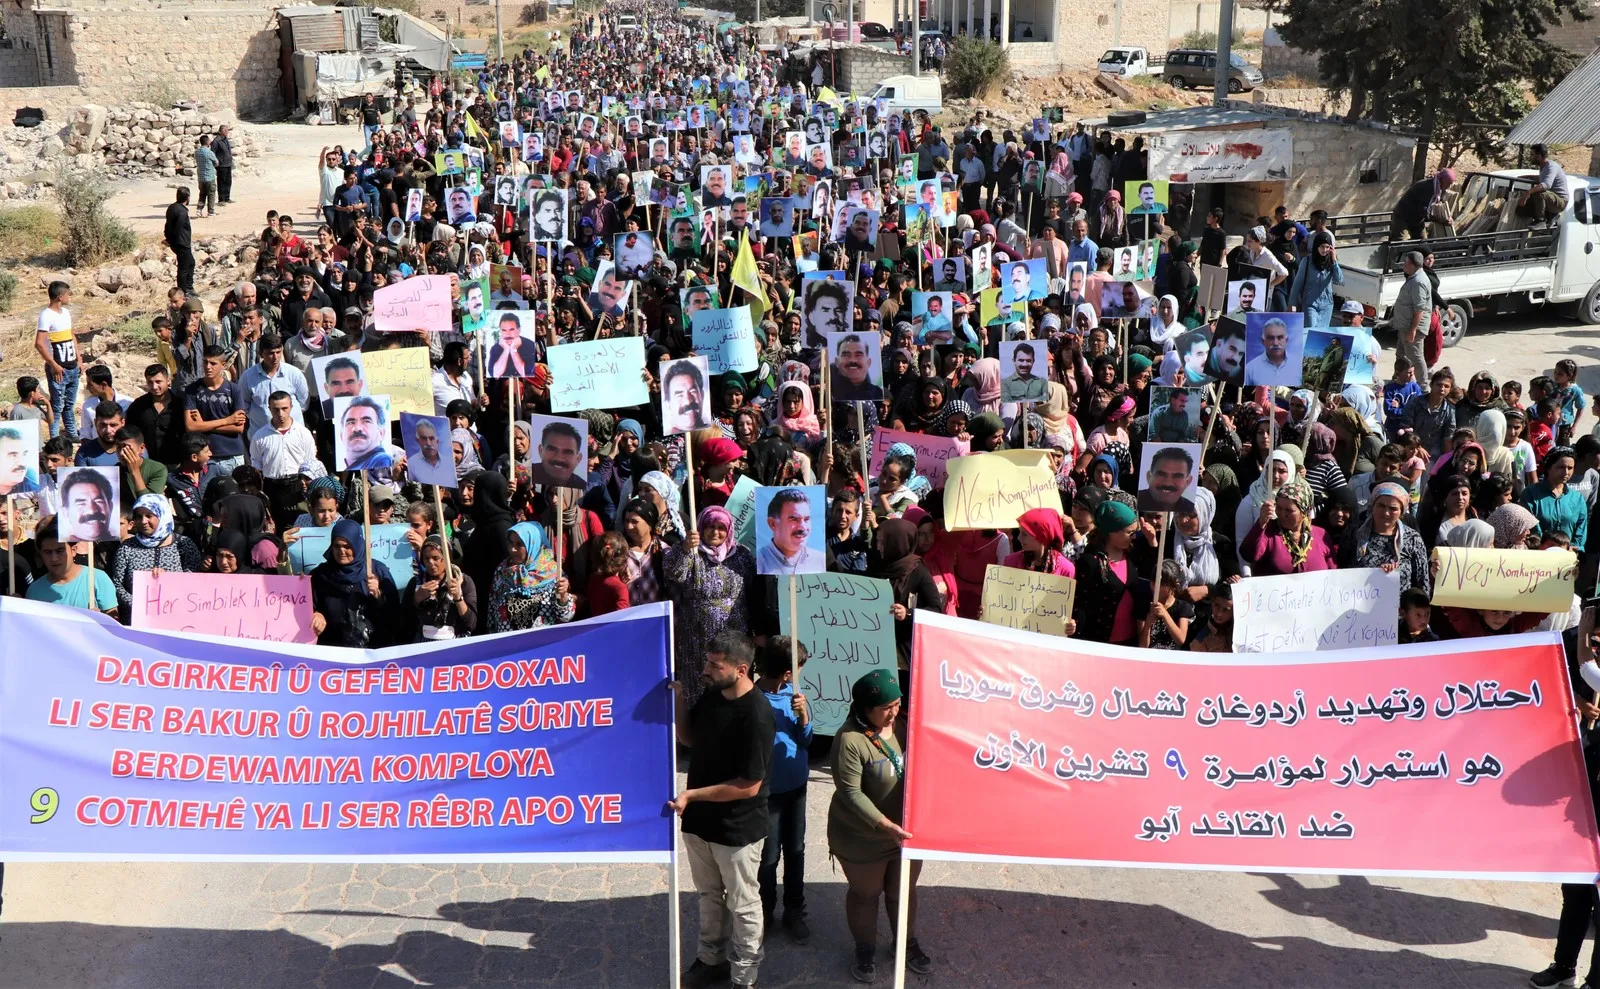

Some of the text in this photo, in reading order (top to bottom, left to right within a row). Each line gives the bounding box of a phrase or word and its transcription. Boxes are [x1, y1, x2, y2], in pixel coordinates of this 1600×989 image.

[145, 584, 179, 616] Her
[253, 587, 261, 608] li
[265, 590, 308, 620] rojava
[855, 579, 880, 601] لا
[1339, 586, 1381, 619] rojava
[810, 605, 881, 635] لا للظلم
[1361, 622, 1397, 647] rojava
[806, 638, 881, 665] لا للإبادا
[96, 655, 586, 694] DAGIRKERÎ Û GEFÊN ERDOXAN
[940, 660, 1541, 727] احتلال وتهديد أردوغان لشمال وشرق سوريا
[49, 697, 611, 739] LI SER BAKUR Û ROJHILATÊ SÛRIYE
[111, 748, 553, 784] BERDEWAMIYA KOMPLOYA
[974, 730, 1503, 790] هو استمرار لمؤامرة ٩ تشرين الأول
[29, 786, 622, 830] 9 COTMEHÊ YA LI SER RÊBR APO YE
[1136, 806, 1354, 842] ضد القائد آبو
